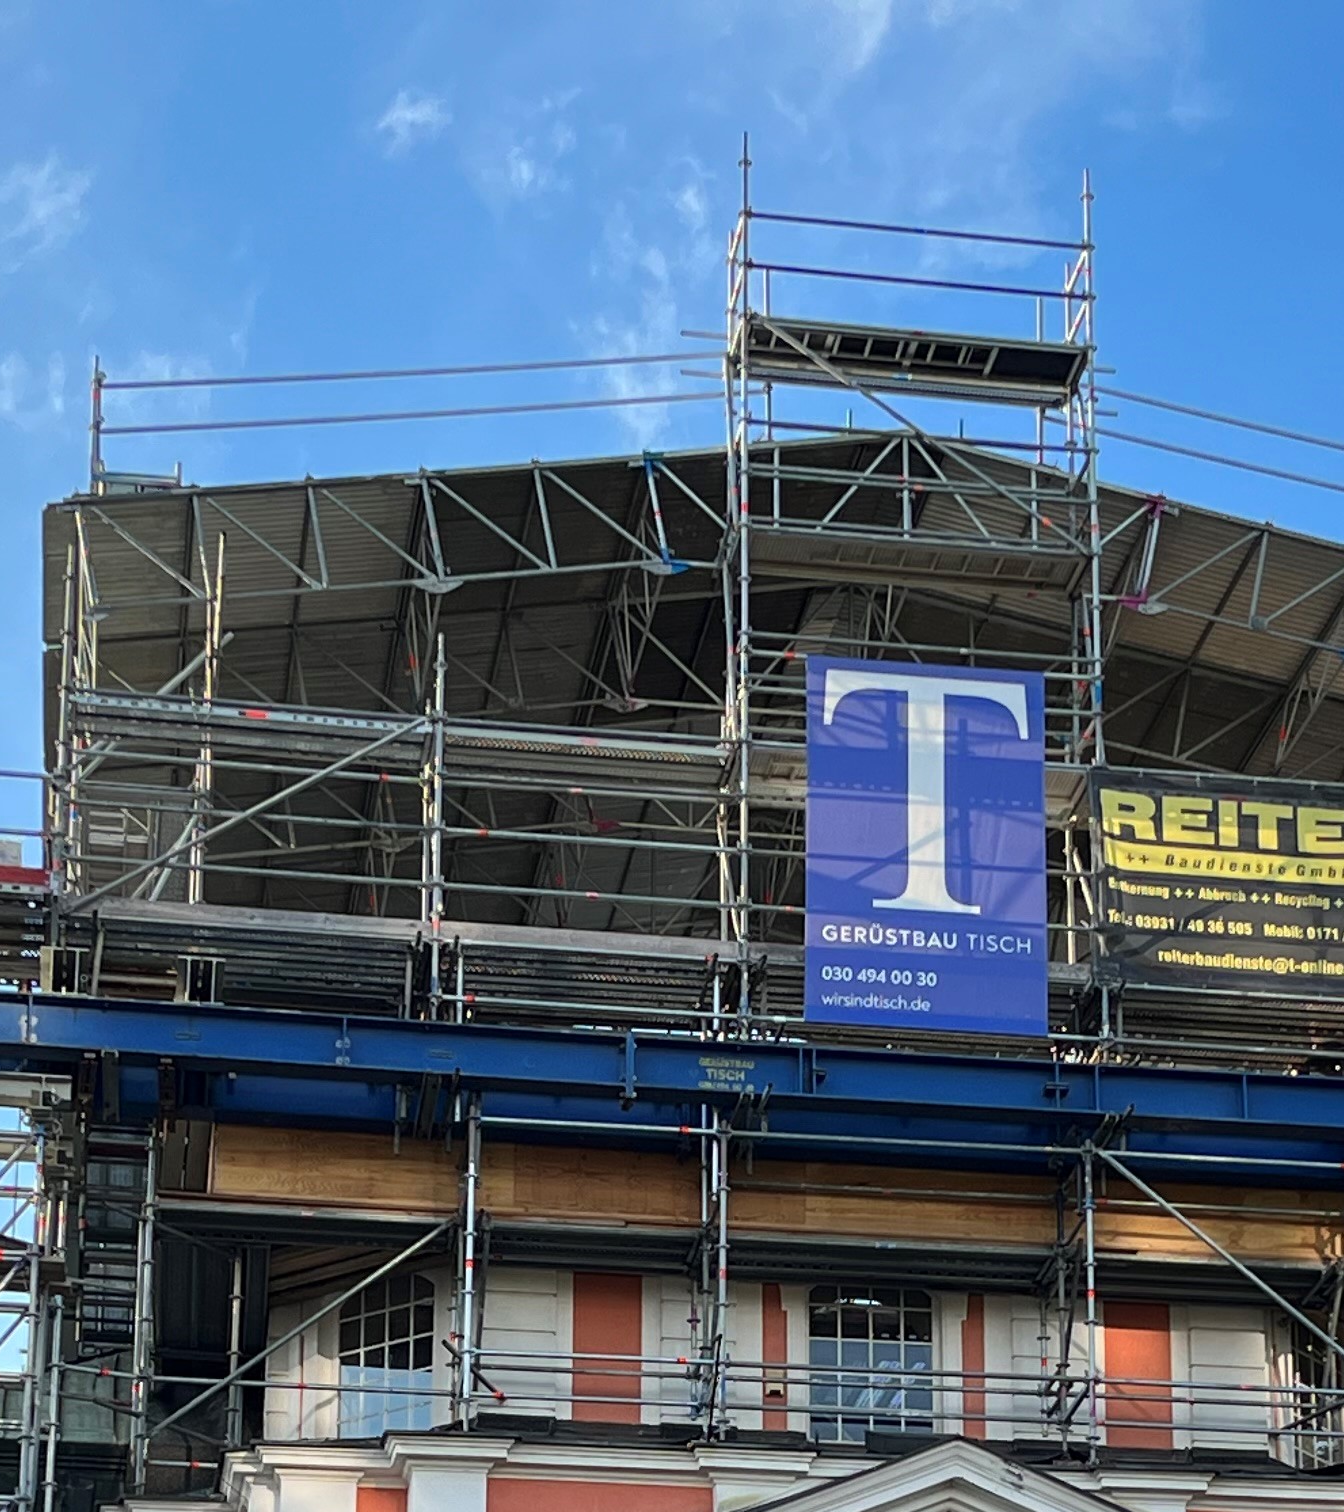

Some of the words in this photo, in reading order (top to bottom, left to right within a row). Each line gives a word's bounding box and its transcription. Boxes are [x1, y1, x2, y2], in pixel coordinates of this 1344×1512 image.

[823, 668, 1029, 915] T
[1165, 854, 1287, 876] Baudienste
[1197, 887, 1246, 902] Abbruch
[1274, 892, 1330, 909] Recycling
[1107, 908, 1132, 926] Tel.:
[1135, 914, 1174, 930] 03931
[1207, 917, 1224, 934] 36
[1227, 921, 1252, 936] 505
[1263, 923, 1303, 939] Mobil:
[1306, 926, 1338, 940] 0171
[822, 925, 957, 949] GERÜSTBAU
[965, 933, 1030, 954] TISCH
[821, 965, 852, 982] 030
[856, 968, 886, 984] 494
[890, 969, 912, 985] 00
[915, 971, 936, 987] 30
[821, 992, 930, 1011] wirsindtisch.de
[706, 1068, 745, 1081] TISCH
